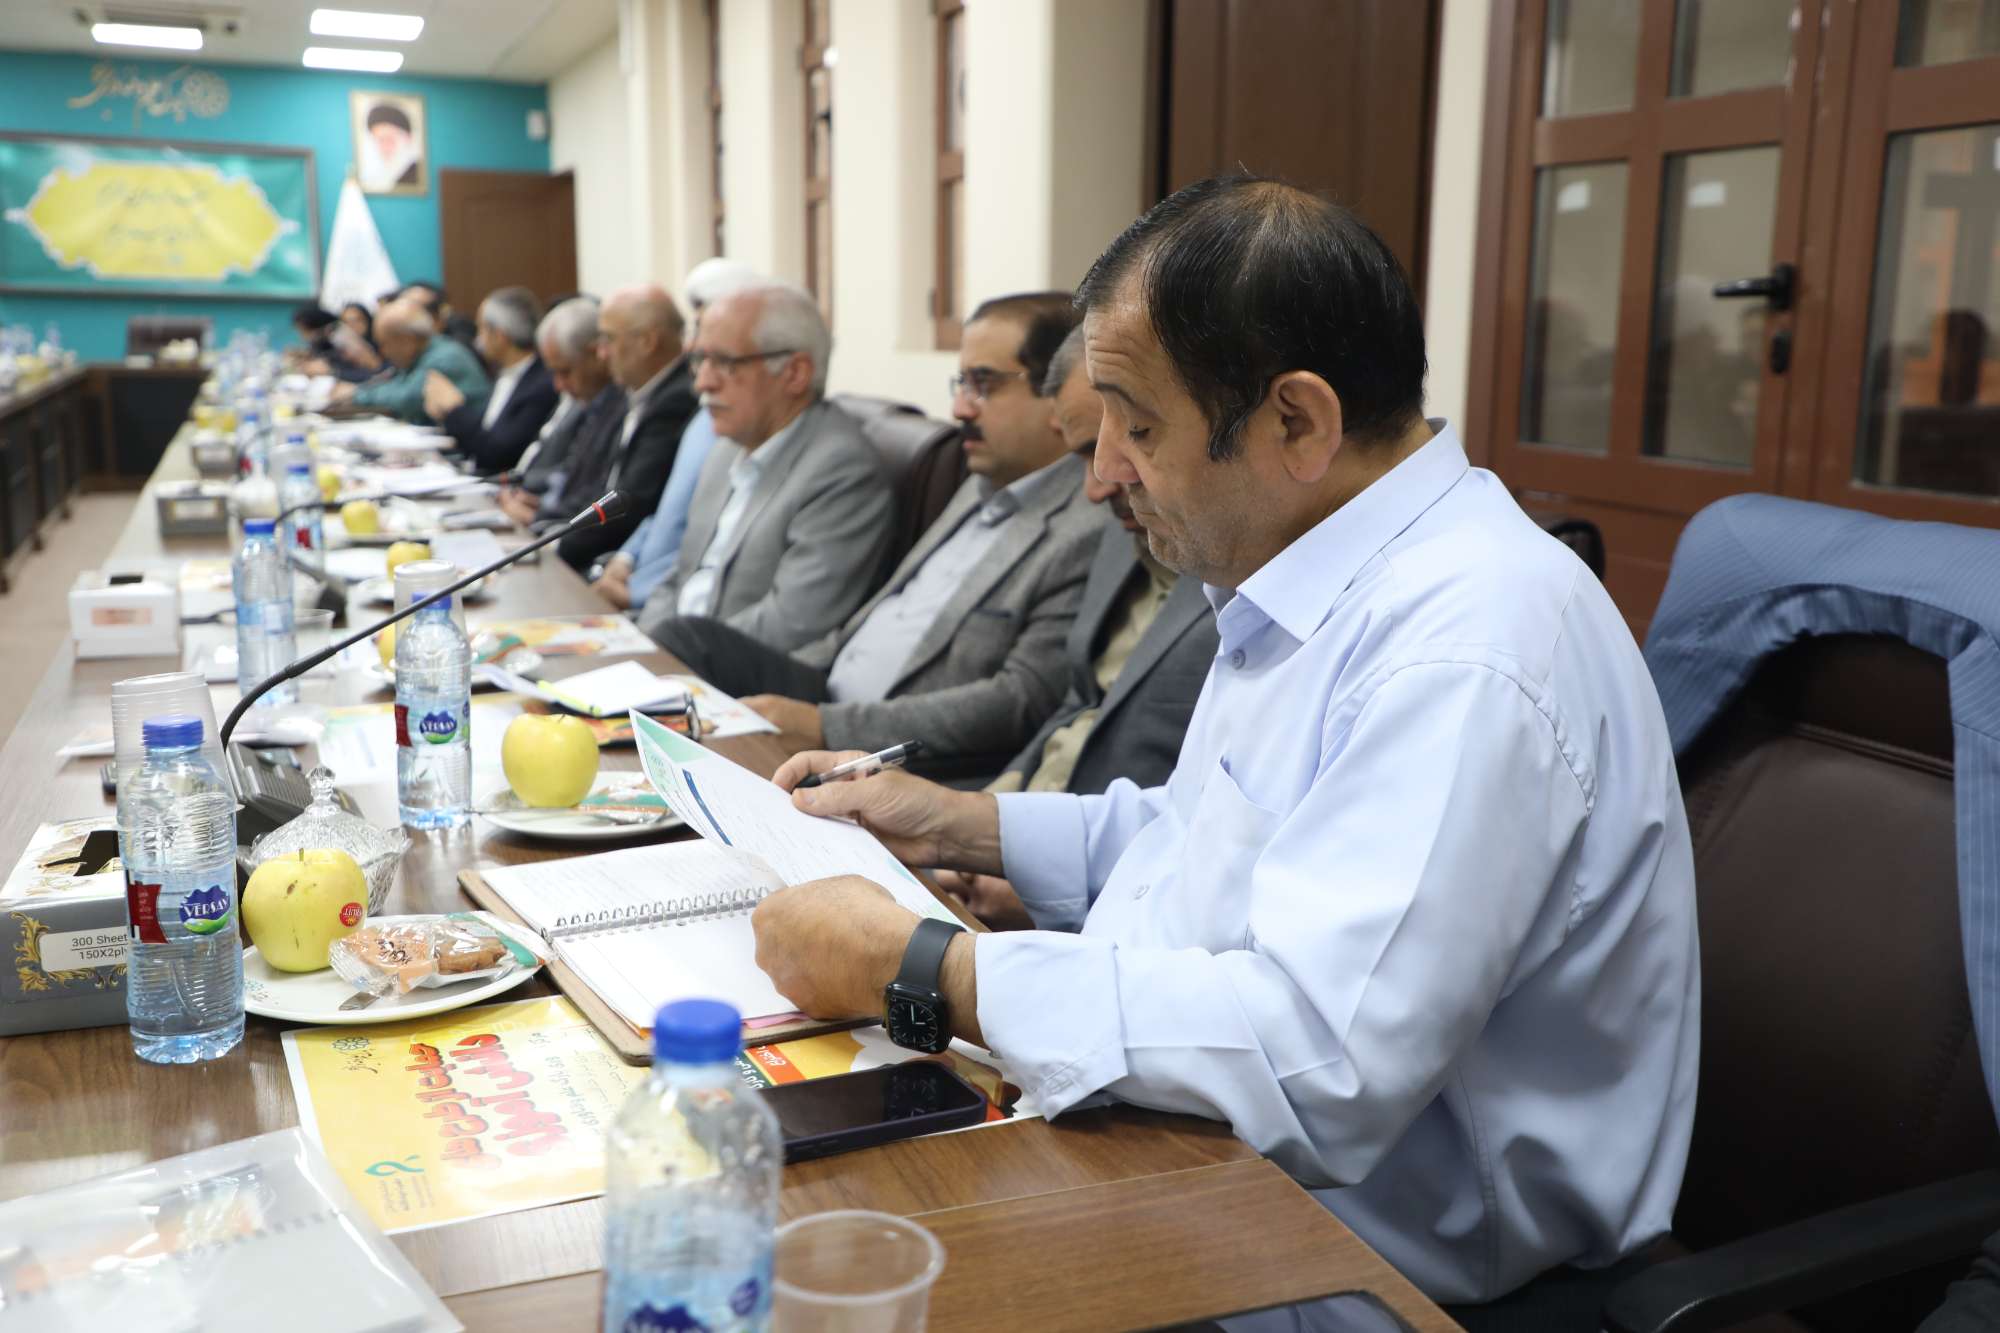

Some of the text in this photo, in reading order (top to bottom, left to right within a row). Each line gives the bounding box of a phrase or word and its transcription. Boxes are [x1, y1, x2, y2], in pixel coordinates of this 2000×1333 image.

[71, 934, 128, 948] 300 Sheet
[405, 1043, 457, 1089] حمایت
[756, 1049, 786, 1066] اختراع
[415, 1088, 472, 1104] از
[449, 1034, 572, 1158] دانش آموزی
[423, 1101, 489, 1138] طرح
